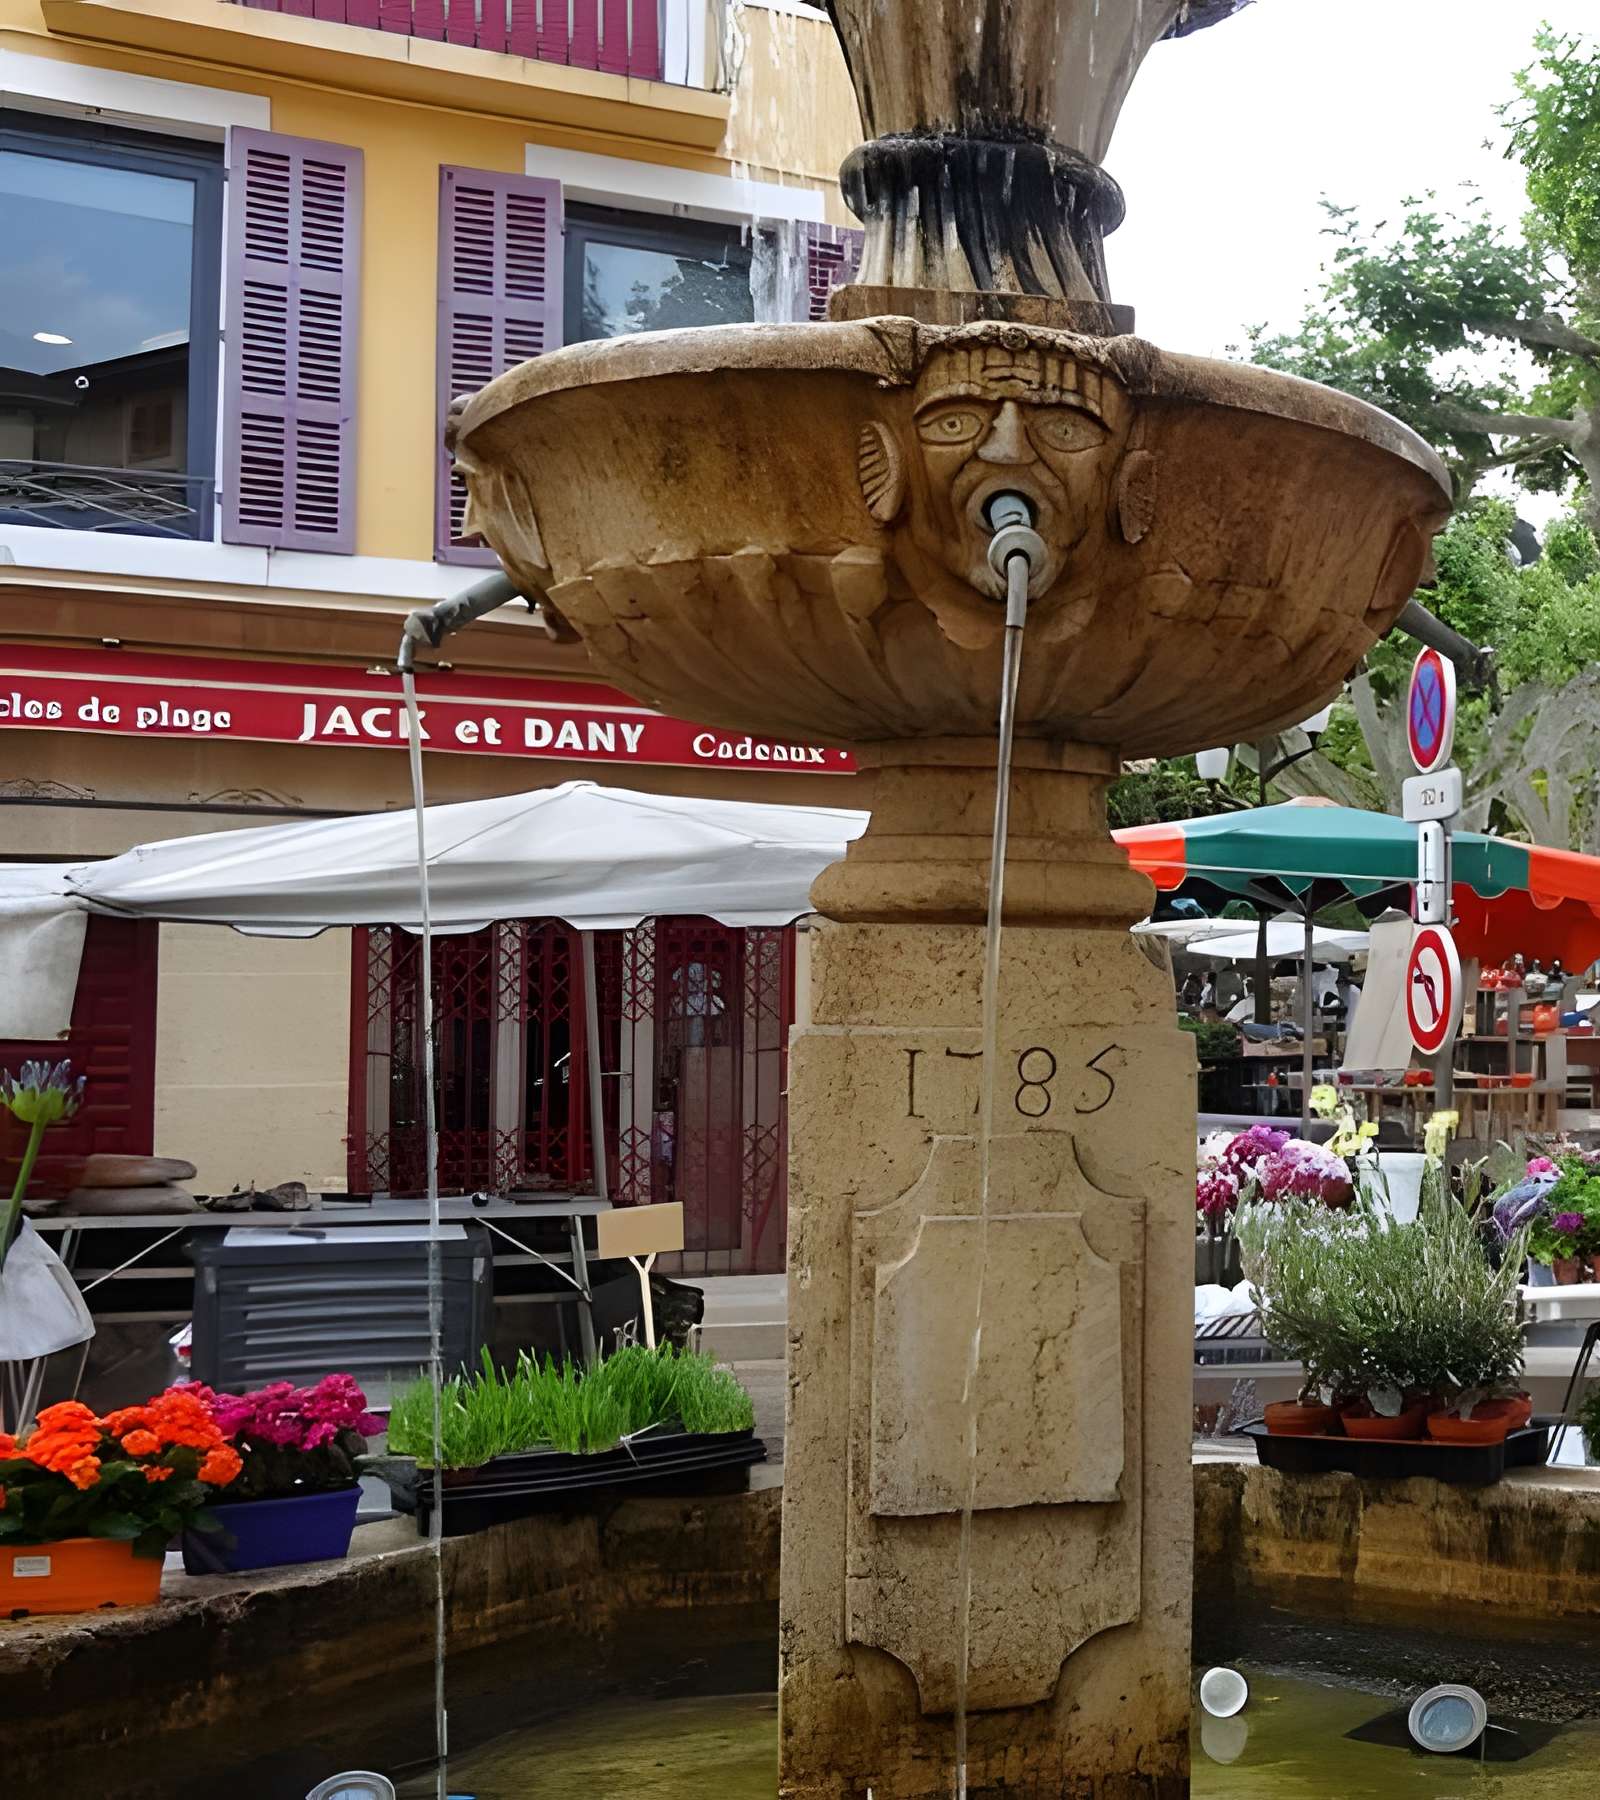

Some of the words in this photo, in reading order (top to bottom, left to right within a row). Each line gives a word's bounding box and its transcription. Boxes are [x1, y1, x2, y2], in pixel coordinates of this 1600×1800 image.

[78, 696, 120, 723] de
[298, 703, 431, 741] JACK
[455, 717, 502, 745] et
[524, 718, 645, 753] DANY
[692, 733, 825, 764] Cadeaux
[903, 1044, 1126, 1118] 1785
